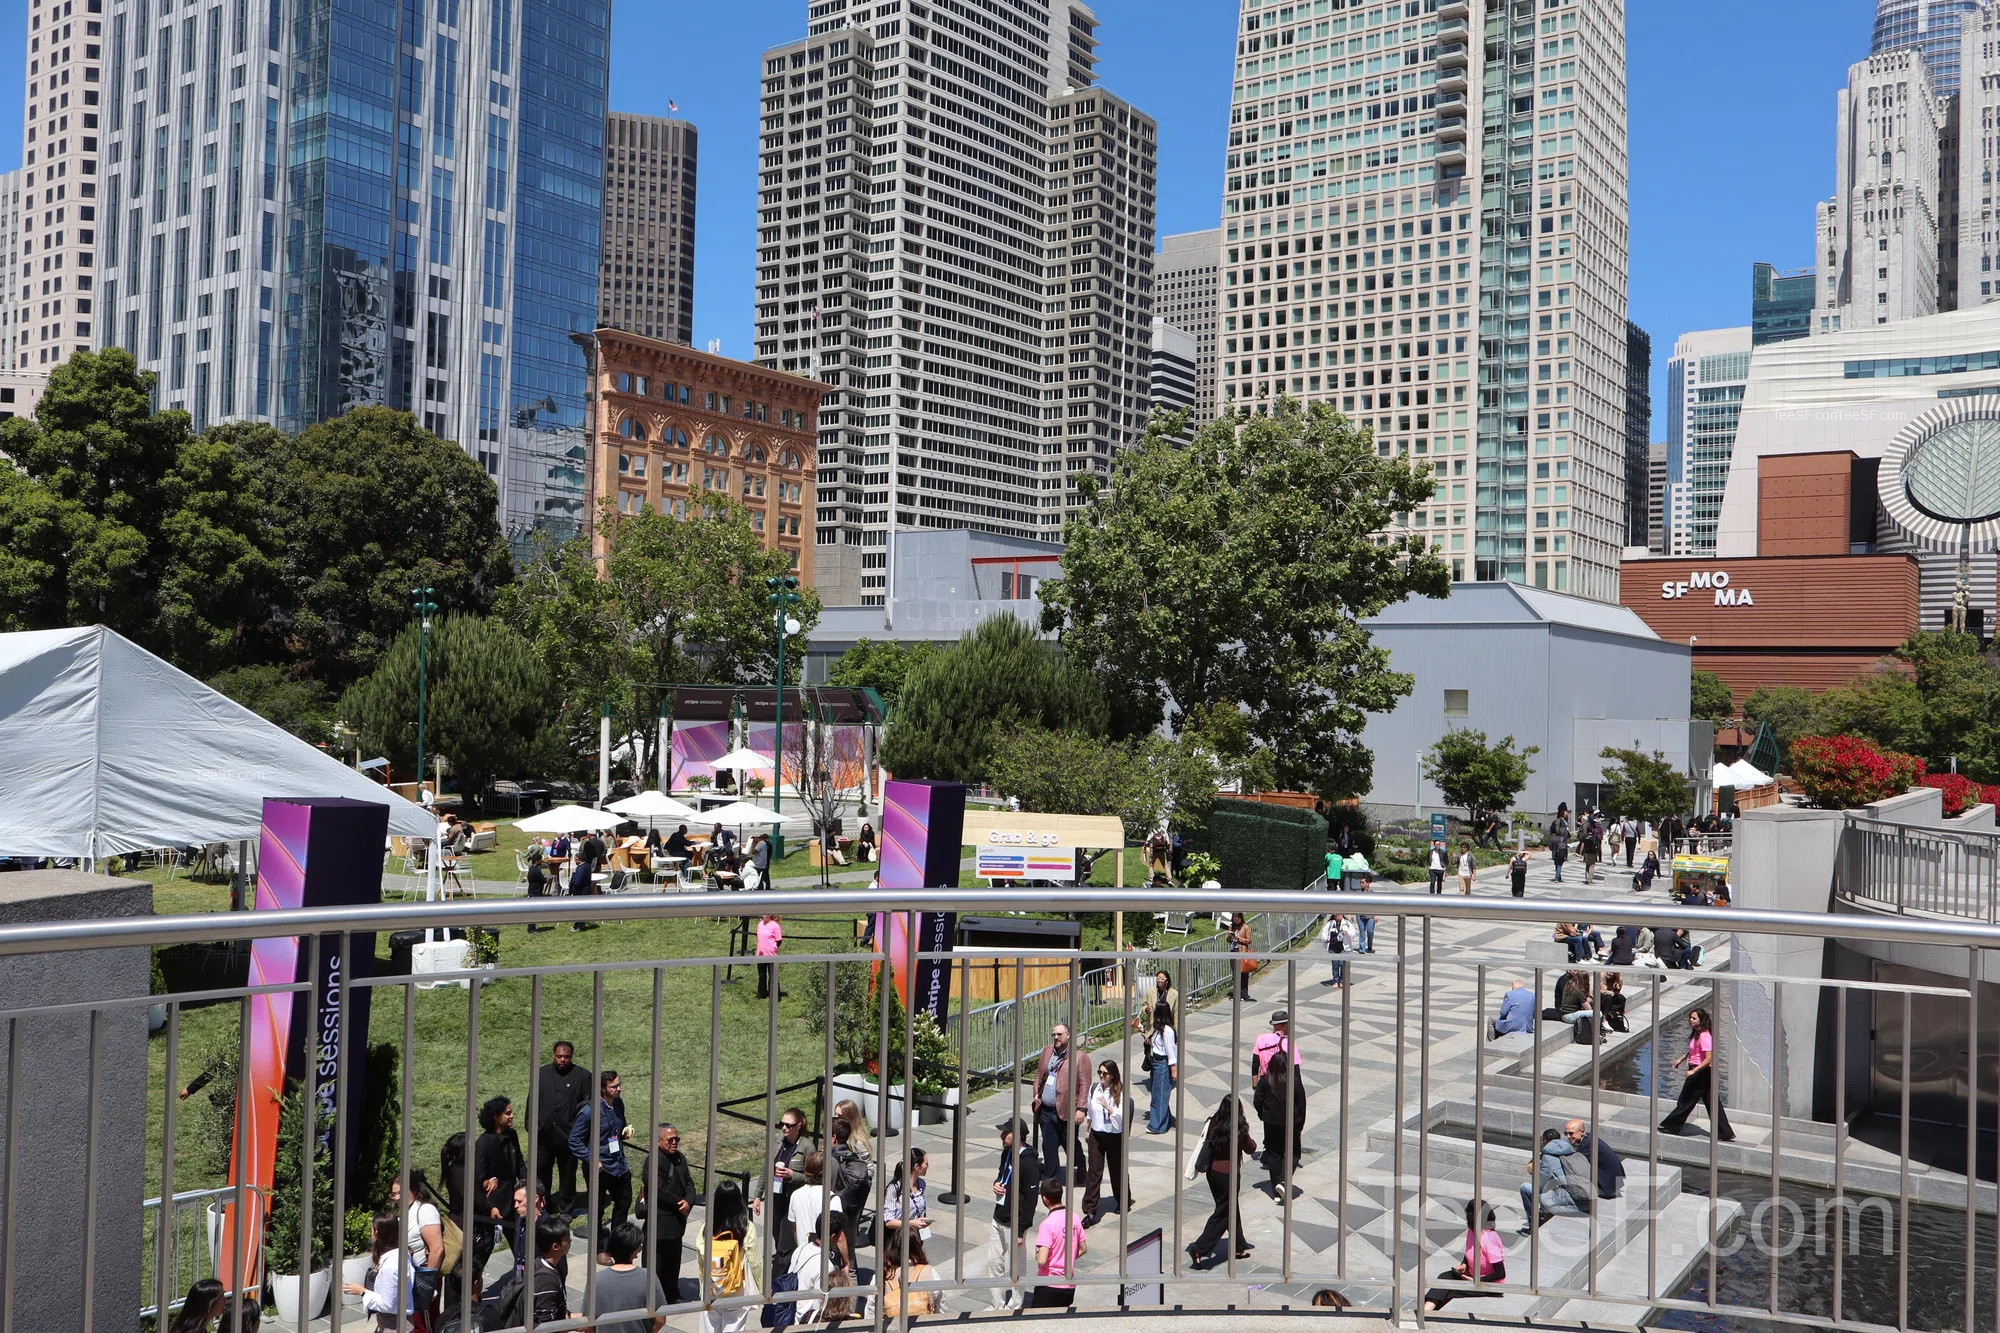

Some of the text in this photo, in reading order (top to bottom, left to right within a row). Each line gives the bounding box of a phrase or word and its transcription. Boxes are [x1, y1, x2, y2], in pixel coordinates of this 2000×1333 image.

[1661, 581, 1689, 599] SF
[1714, 588, 1754, 606] MA
[988, 829, 1059, 848] Grab & go
[319, 955, 342, 1077] sessions
